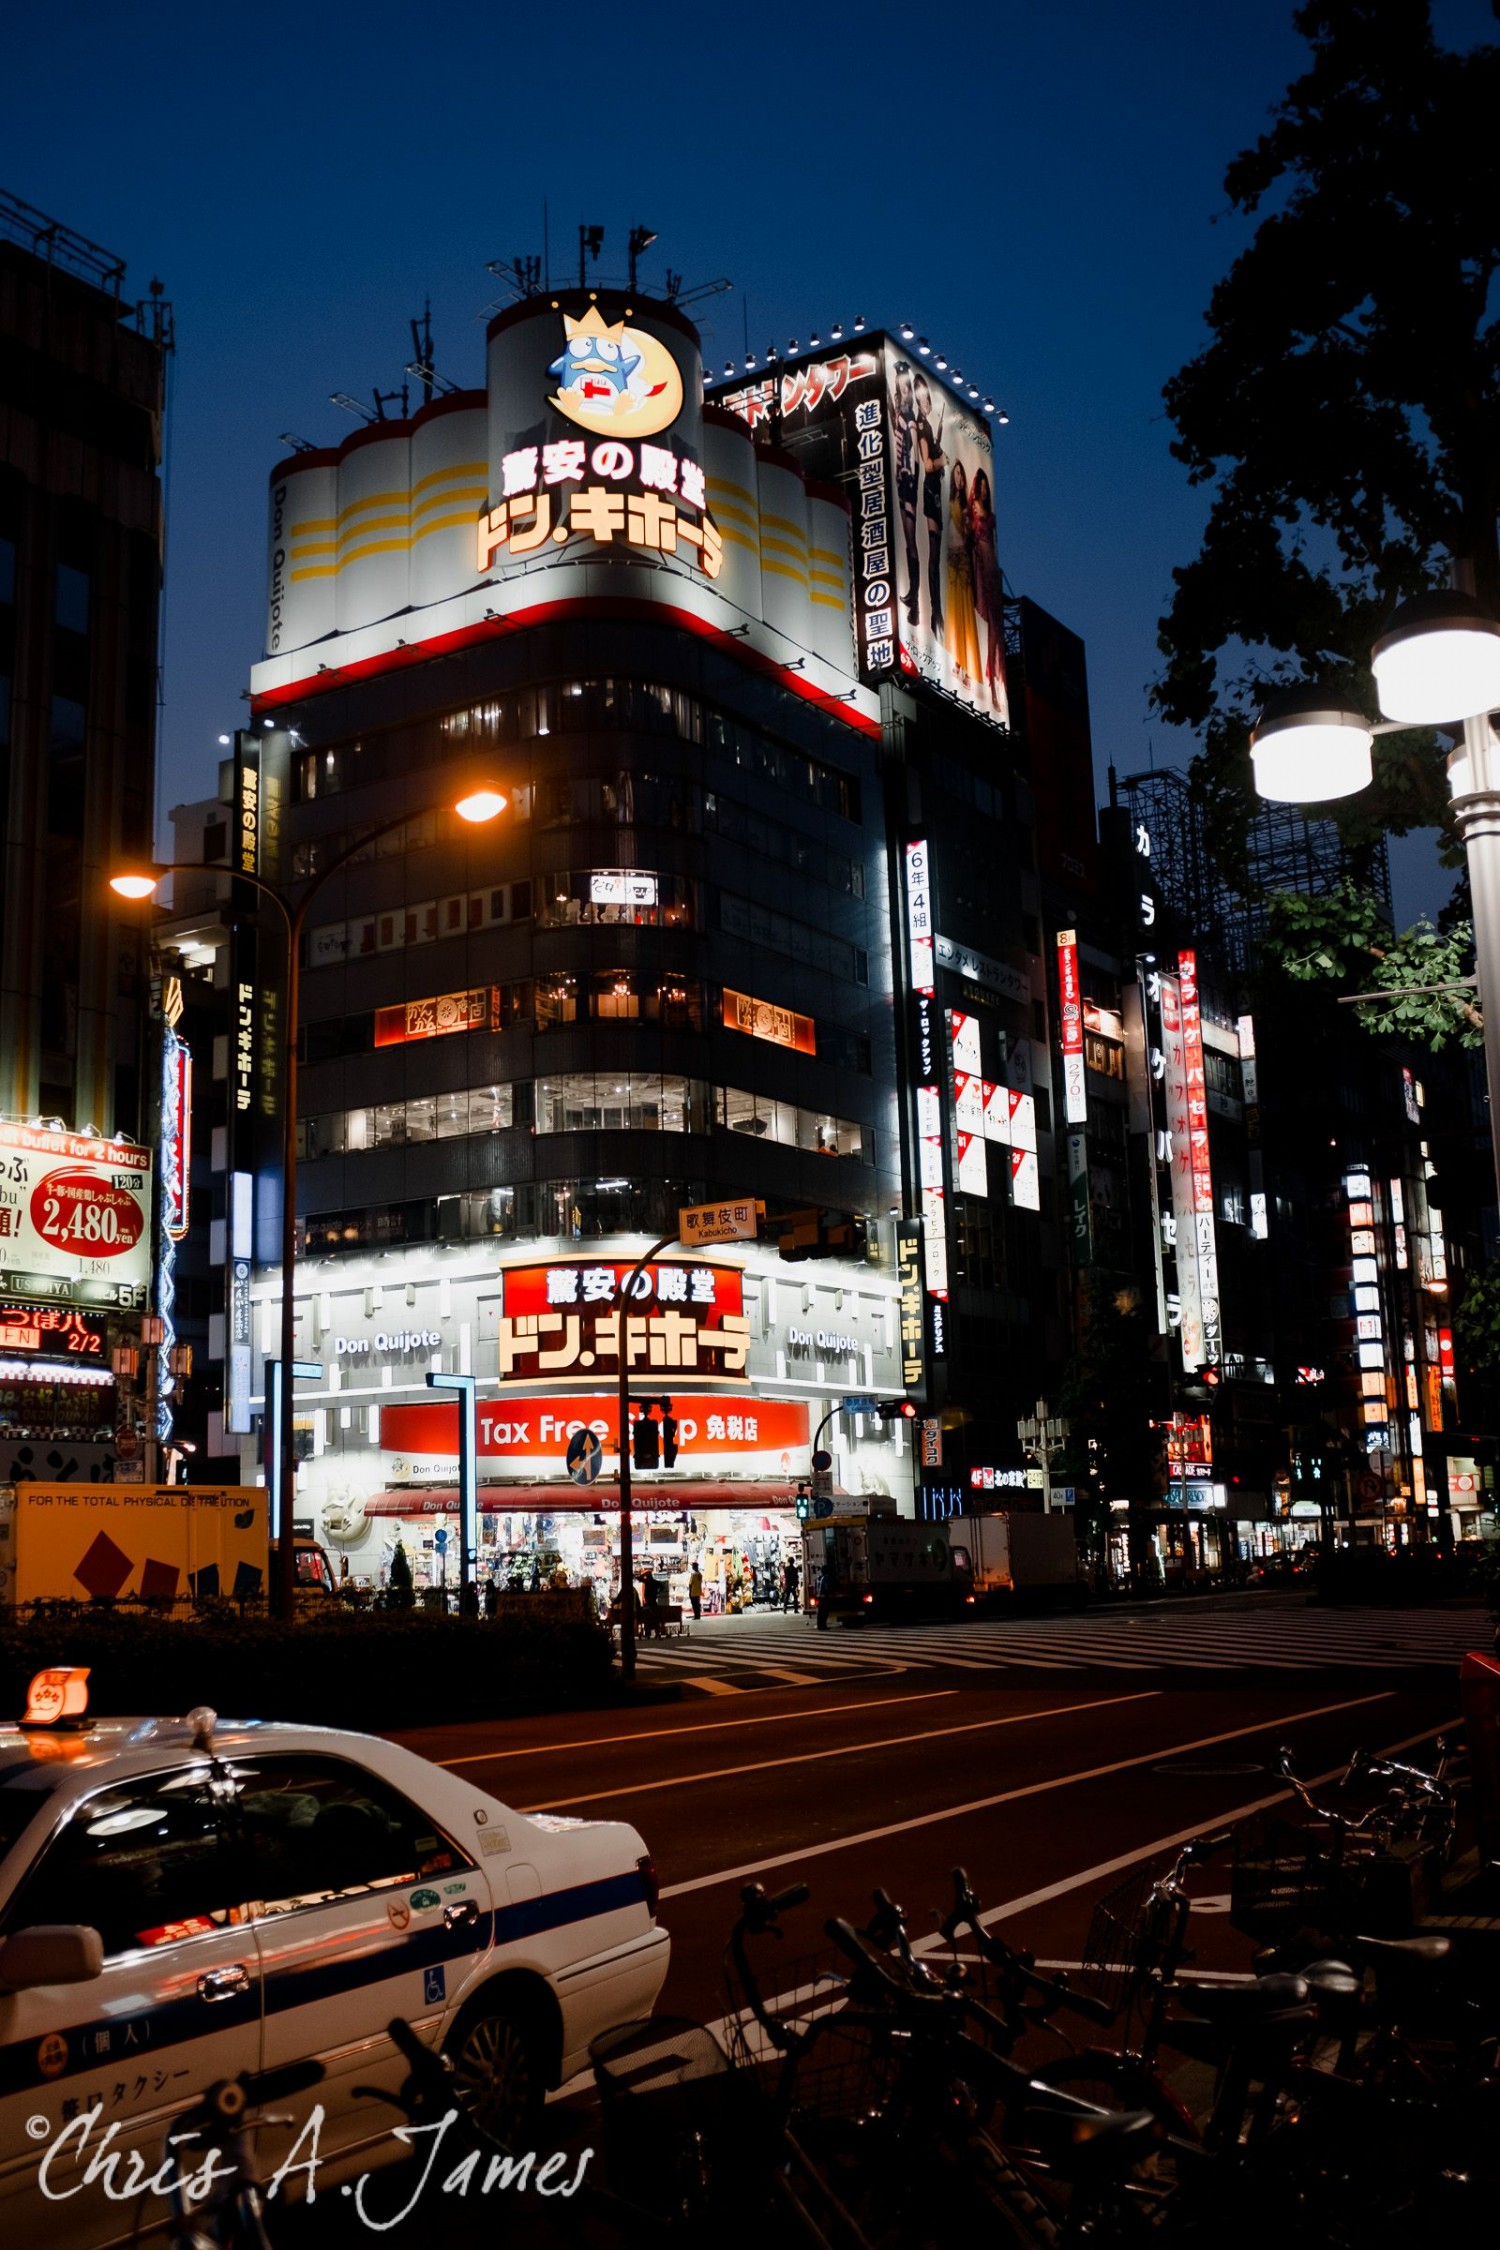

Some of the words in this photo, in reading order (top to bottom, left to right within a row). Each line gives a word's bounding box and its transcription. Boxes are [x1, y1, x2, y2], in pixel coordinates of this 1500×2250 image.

[272, 484, 286, 541] Don
[857, 400, 897, 671] 進化型居酒屋の聖地
[70, 1139, 91, 1157] for
[93, 1142, 105, 1160] 2
[107, 1145, 149, 1168] hours
[113, 1174, 143, 1191] 120分
[42, 1198, 118, 1244] 2,480
[115, 1232, 133, 1245] yen
[686, 1206, 749, 1229] 歌舞伎町
[698, 1226, 738, 1239] Kabukicho
[546, 1268, 716, 1305] 驚安の殿堂
[2, 1310, 87, 1334] つぼ八
[69, 1334, 100, 1352] 2/2
[335, 1336, 369, 1355] Don
[373, 1330, 441, 1353] Quijote
[789, 1326, 813, 1346] Don
[816, 1330, 859, 1354] Quijote
[481, 1418, 530, 1446] Tax
[540, 1415, 610, 1443] Free
[706, 1414, 758, 1442] 免税店
[412, 1465, 430, 1474] Don
[28, 1495, 53, 1507] FOR
[58, 1496, 79, 1507] THE
[83, 1496, 119, 1507] TOTAL
[124, 1496, 177, 1508] PHYSICAL
[422, 1501, 443, 1511] Don
[631, 1497, 681, 1510] Quijote
